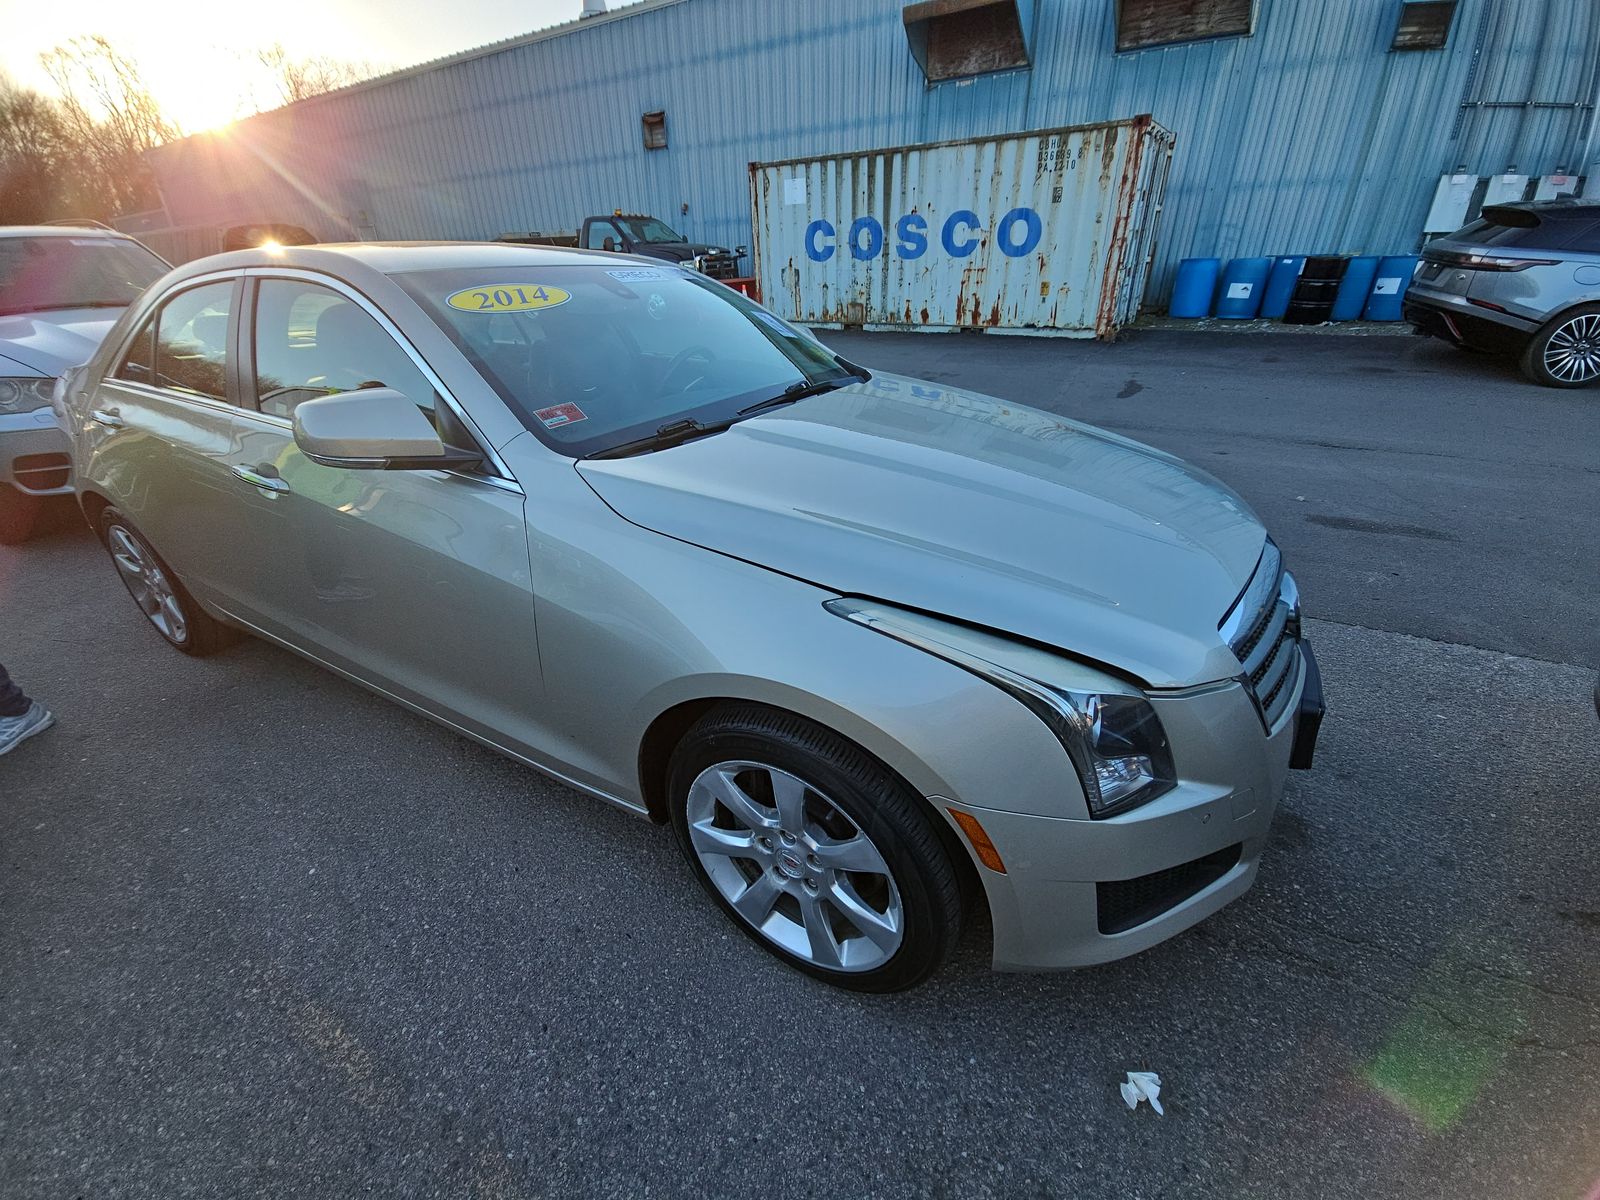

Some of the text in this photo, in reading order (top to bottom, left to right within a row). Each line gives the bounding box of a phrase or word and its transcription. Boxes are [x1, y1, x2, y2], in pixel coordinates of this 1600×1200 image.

[1039, 138, 1062, 150] CBHU
[1037, 148, 1072, 161] 036689
[805, 207, 1043, 262] COSCO
[472, 286, 550, 310] 2014
